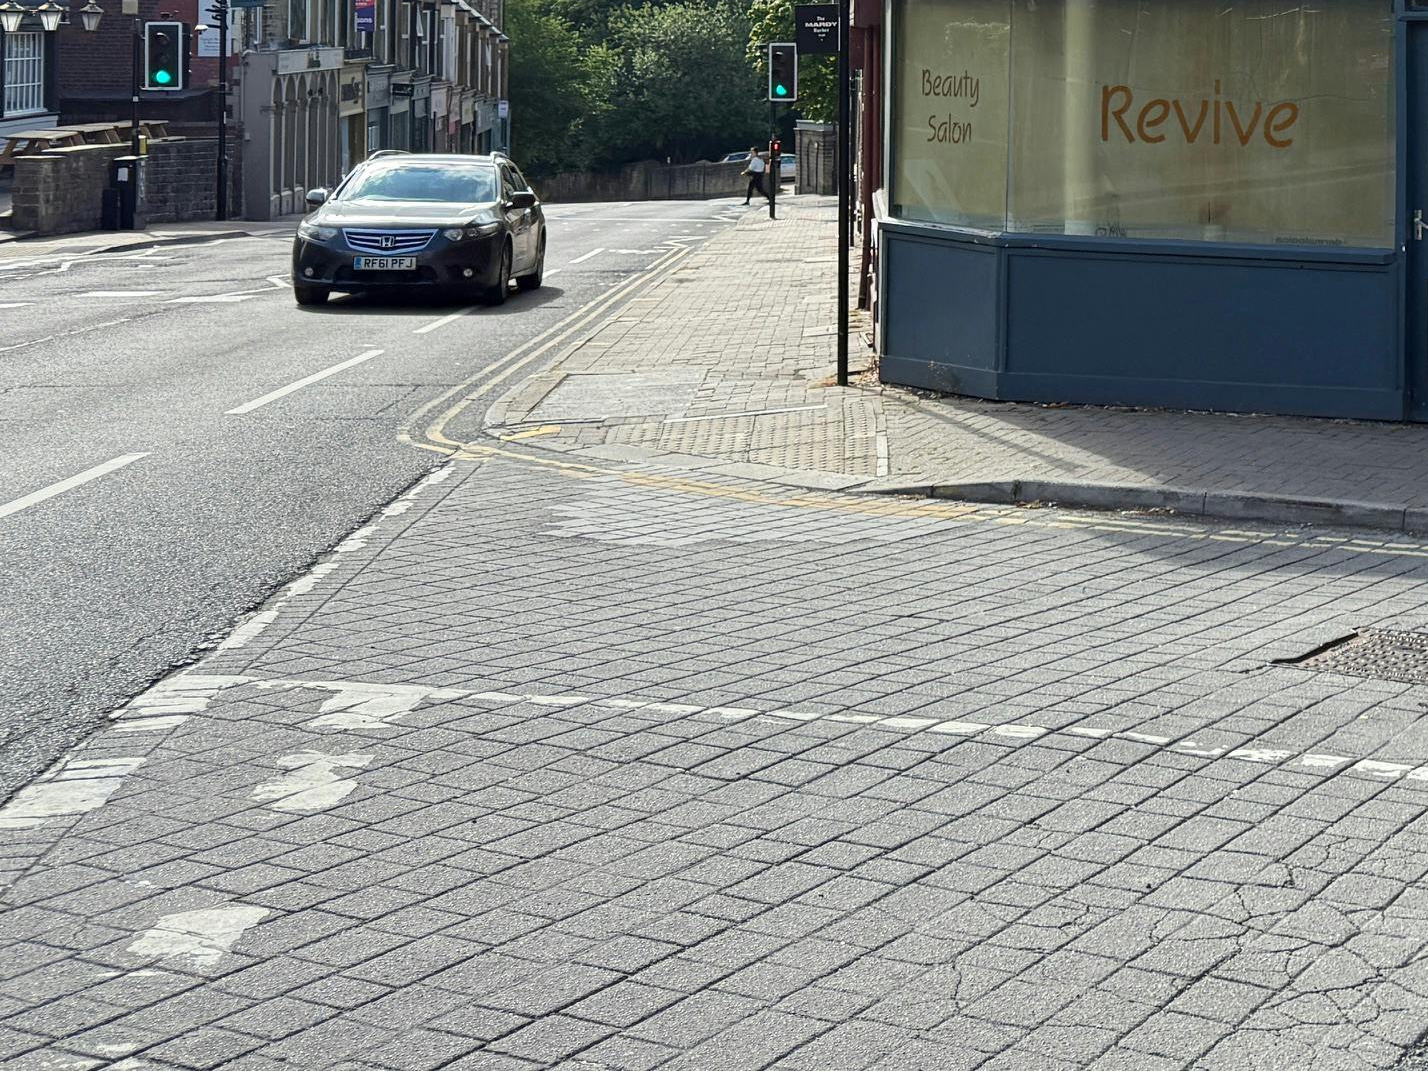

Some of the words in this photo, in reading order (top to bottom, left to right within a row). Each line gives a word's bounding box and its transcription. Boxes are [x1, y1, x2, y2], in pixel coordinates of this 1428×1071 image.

[922, 69, 980, 107] Beauty
[926, 112, 972, 144] Salon
[1101, 79, 1300, 148] Revive
[363, 258, 389, 269] RF61
[391, 258, 413, 269] PFJ
